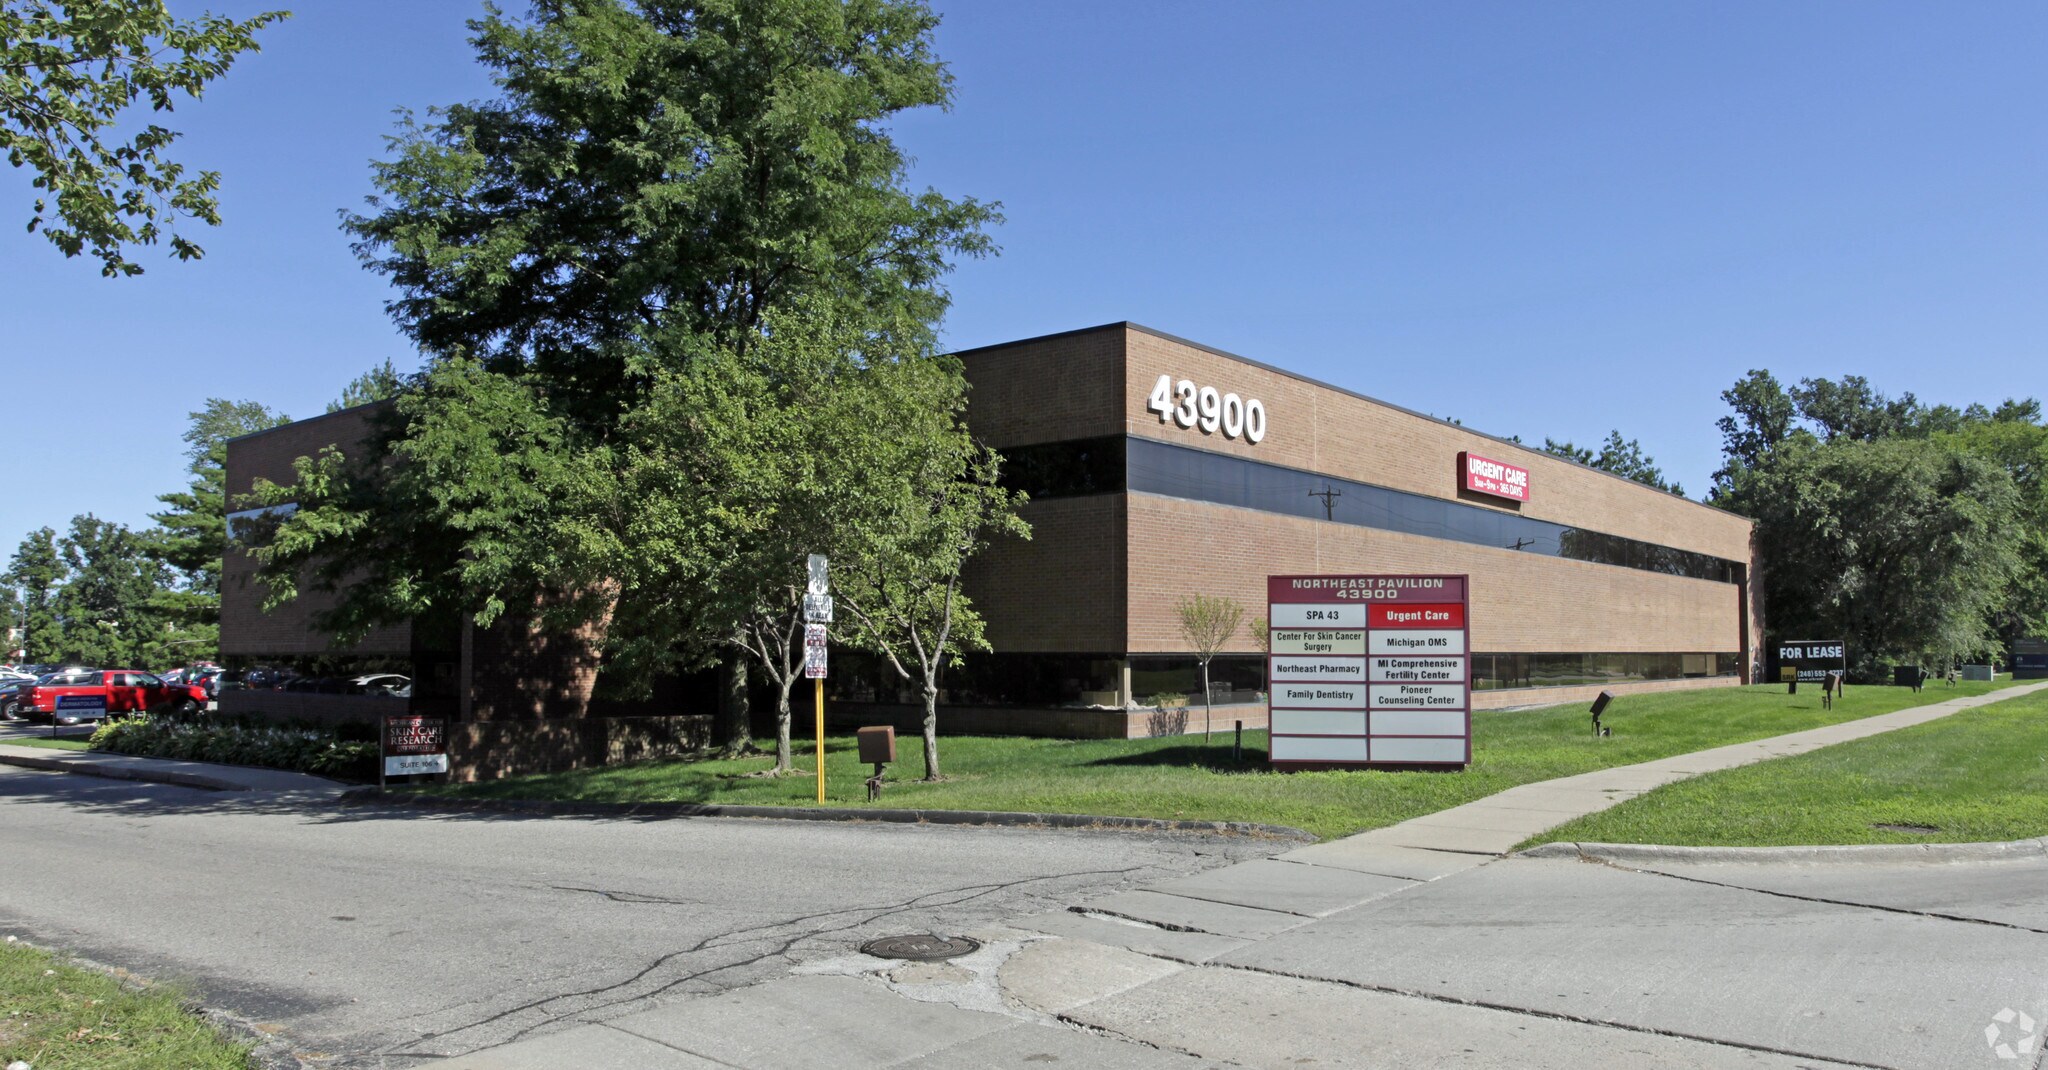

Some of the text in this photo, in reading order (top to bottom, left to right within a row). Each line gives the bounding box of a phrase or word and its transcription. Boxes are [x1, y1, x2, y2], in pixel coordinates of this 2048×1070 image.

[1148, 374, 1266, 443] 43900
[1469, 458, 1526, 487] URGENT CARE
[1500, 482, 1509, 494] 365
[1509, 484, 1523, 497] DAYS
[1292, 578, 1443, 589] NORTHEAST PAVILION
[1336, 589, 1398, 599] 43900
[1306, 611, 1339, 620] SPA 43
[1387, 611, 1449, 622] Urgent Care
[1277, 632, 1361, 641] Center For Skin Cancer
[1304, 642, 1332, 652] Surgery
[1387, 638, 1447, 648] Michigan OMS
[1780, 646, 1842, 659] FOR LEASE
[1277, 664, 1360, 675] Northeast Pharmacy
[1378, 659, 1458, 670] MI Comprehensive
[1385, 671, 1450, 681] Fertility Center
[1400, 685, 1433, 694] Pioneer
[1287, 690, 1354, 700] Family Dentistry
[1378, 696, 1455, 706] Counseling Center
[390, 726, 443, 736] SKIN CARE
[390, 735, 443, 745] RESEARCH
